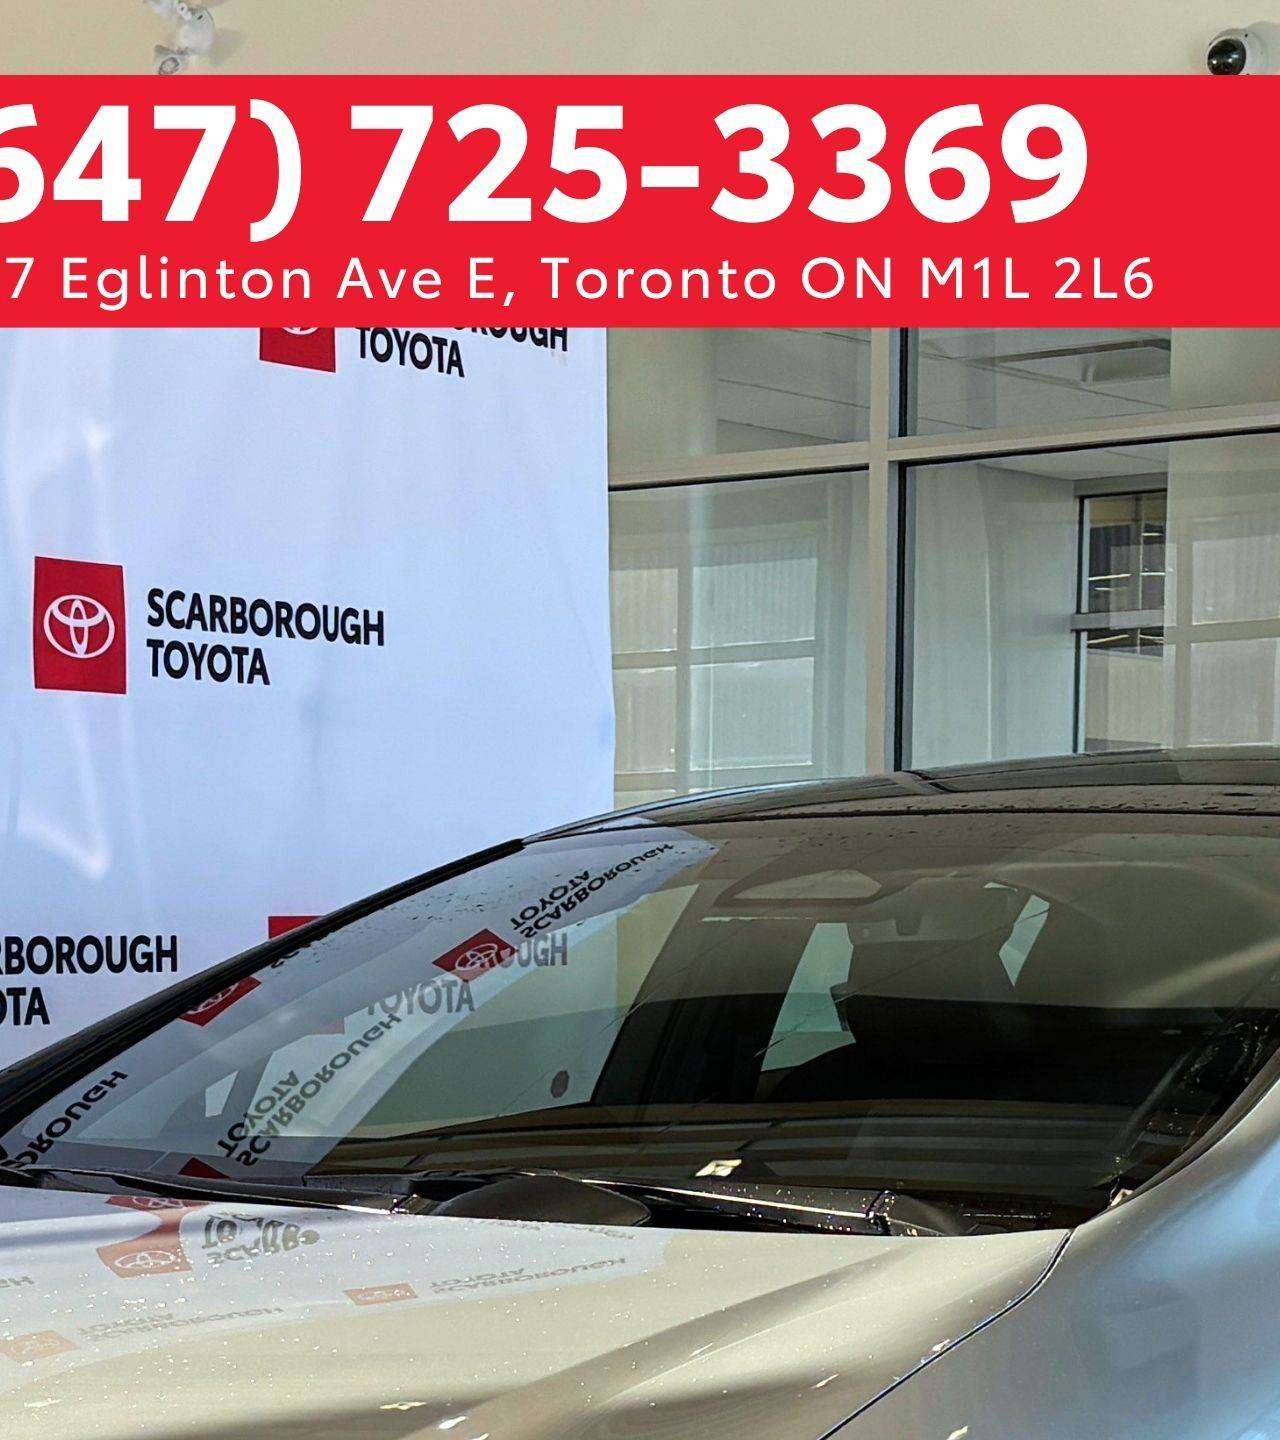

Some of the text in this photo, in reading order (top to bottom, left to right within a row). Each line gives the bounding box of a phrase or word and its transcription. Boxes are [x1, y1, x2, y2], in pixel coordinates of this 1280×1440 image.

[355, 326, 465, 378] TOYOTA
[147, 588, 385, 647] SCARBOROUGH
[146, 638, 271, 686] TOYOTA
